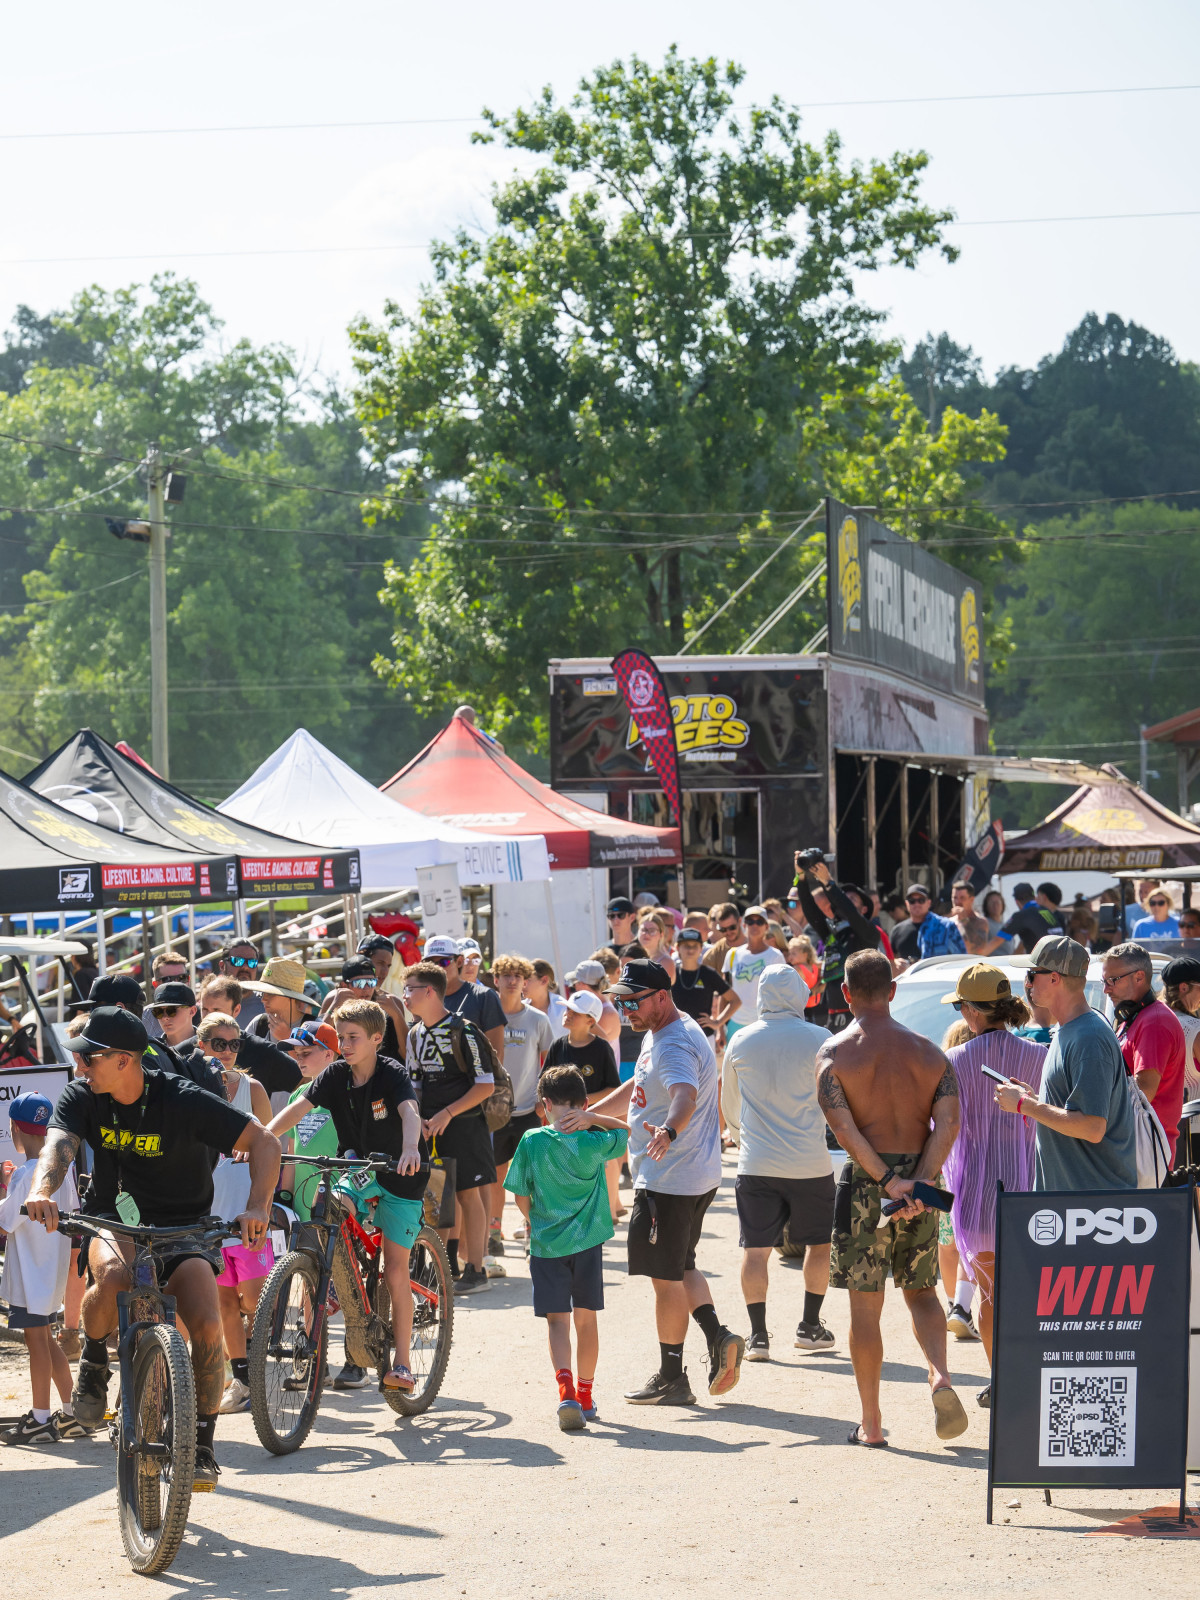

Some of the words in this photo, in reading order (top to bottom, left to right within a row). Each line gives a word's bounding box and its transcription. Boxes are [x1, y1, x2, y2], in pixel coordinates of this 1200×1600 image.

[464, 846, 504, 875] REVIVE
[1042, 850, 1162, 869] mototees.com
[104, 868, 140, 886] LIFESTYLE.
[141, 867, 164, 884] RACING.
[165, 866, 194, 882] CULTURE.
[1065, 1207, 1158, 1246] PSD
[1036, 1265, 1155, 1316] WIN
[1039, 1321, 1060, 1331] THIS
[1062, 1321, 1083, 1331] KTM
[1084, 1321, 1106, 1331] SX-E
[1107, 1321, 1115, 1330] 5
[1116, 1321, 1142, 1330] BIKE!
[1043, 1351, 1060, 1361] SCAN
[1062, 1351, 1074, 1361] THE
[1076, 1351, 1084, 1362] QR
[1086, 1351, 1103, 1361] CODE
[1105, 1351, 1114, 1361] TO
[1115, 1350, 1136, 1361] ENTER
